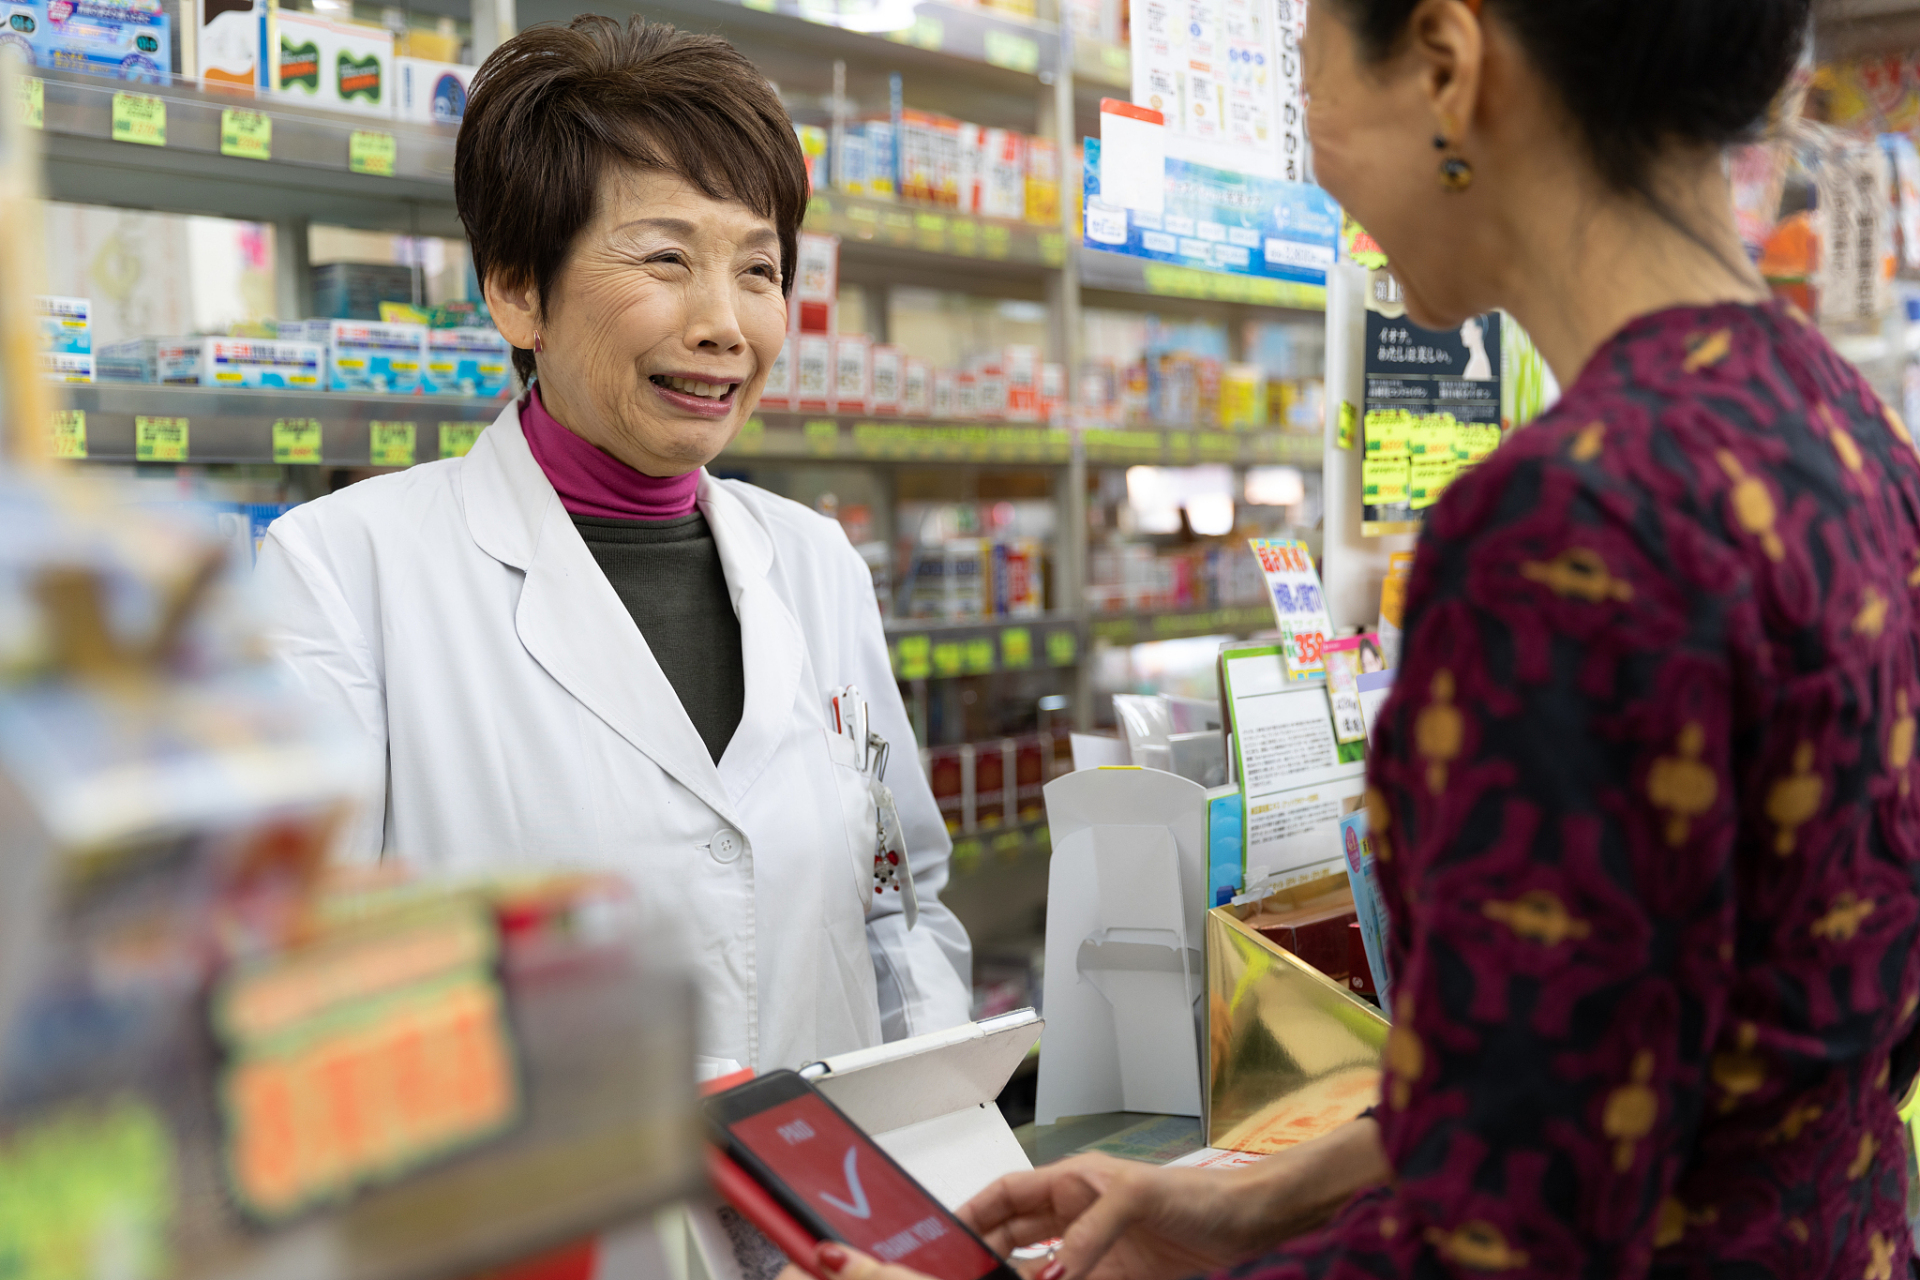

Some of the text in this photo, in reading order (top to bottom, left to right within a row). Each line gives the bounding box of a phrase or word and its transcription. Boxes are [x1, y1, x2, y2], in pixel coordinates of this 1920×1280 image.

[1378, 326, 1412, 345] イオナ。
[1377, 345, 1453, 365] わたしは美しい。
[776, 1119, 816, 1147] PAID
[872, 1230, 922, 1262] THANK
